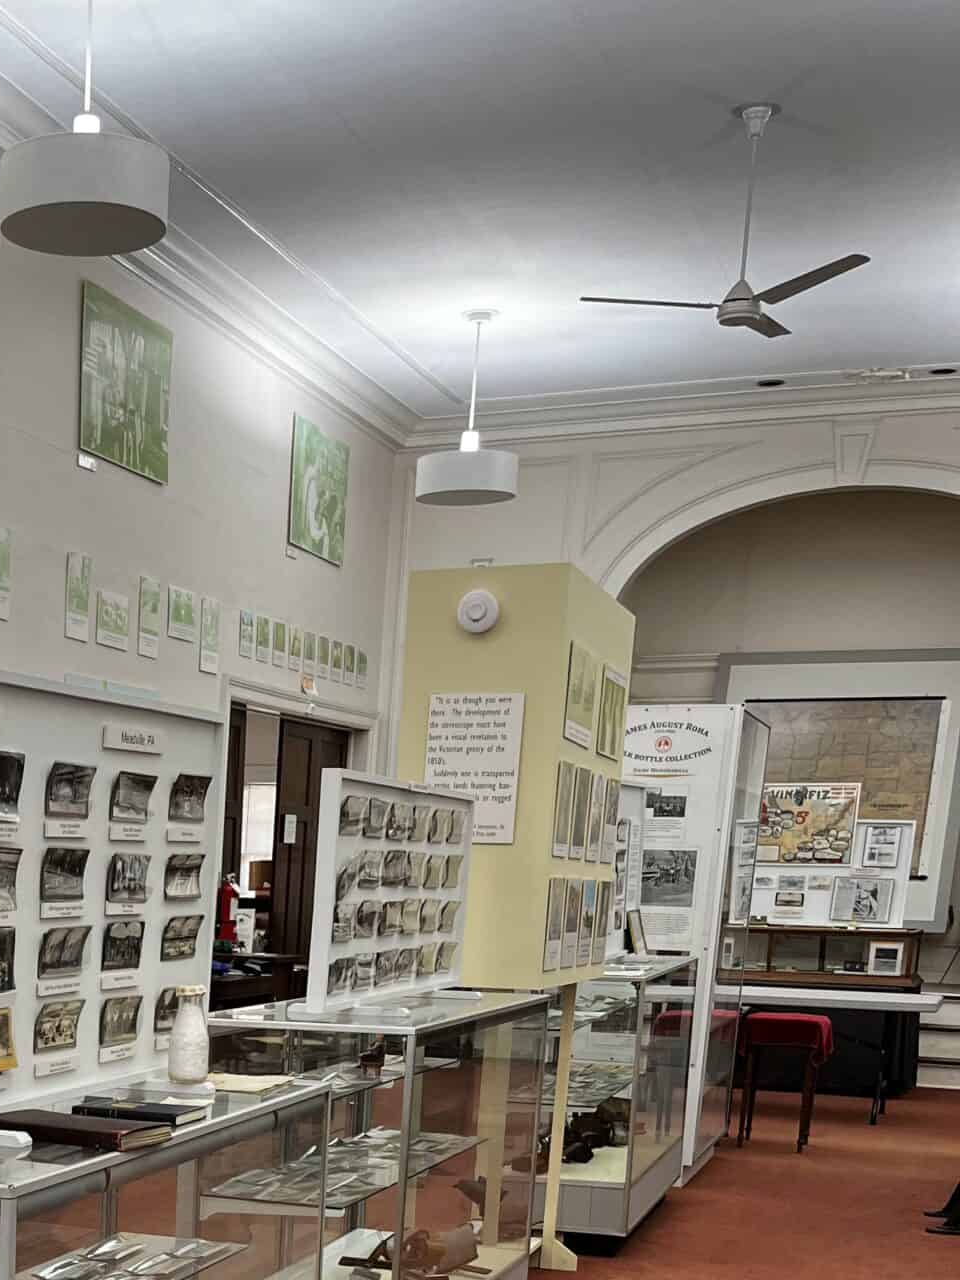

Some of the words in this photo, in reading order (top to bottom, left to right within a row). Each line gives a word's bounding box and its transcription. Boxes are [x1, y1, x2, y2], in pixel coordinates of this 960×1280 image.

[650, 721, 685, 730] AUGUST
[665, 747, 712, 763] COLLECTION
[809, 790, 831, 800] FIZ
